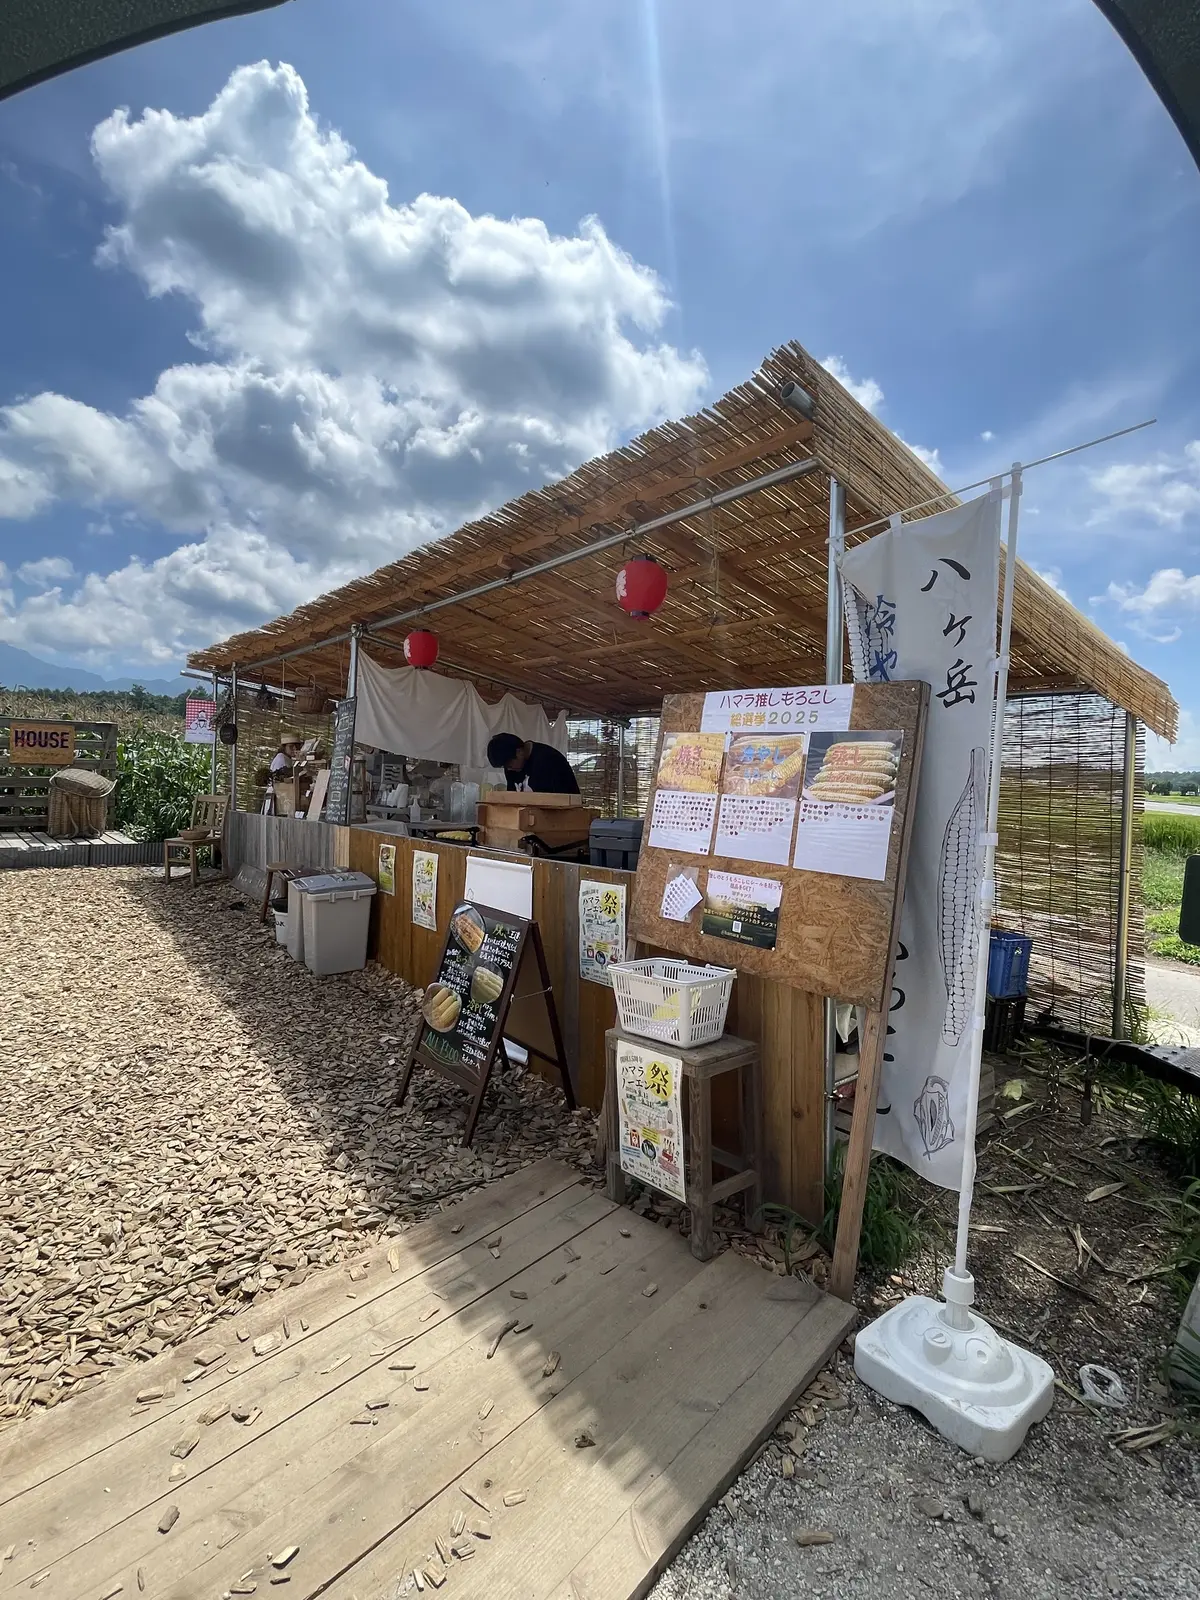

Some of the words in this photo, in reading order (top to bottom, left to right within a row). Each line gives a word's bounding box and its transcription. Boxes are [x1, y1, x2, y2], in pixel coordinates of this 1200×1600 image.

[720, 689, 837, 709] ハマラ推しもろこし
[14, 730, 70, 749] HOUSE
[604, 892, 617, 915] 祭
[621, 1066, 645, 1077] ハマラ
[650, 1063, 669, 1097] 祭
[622, 1078, 651, 1090] ノーエン
